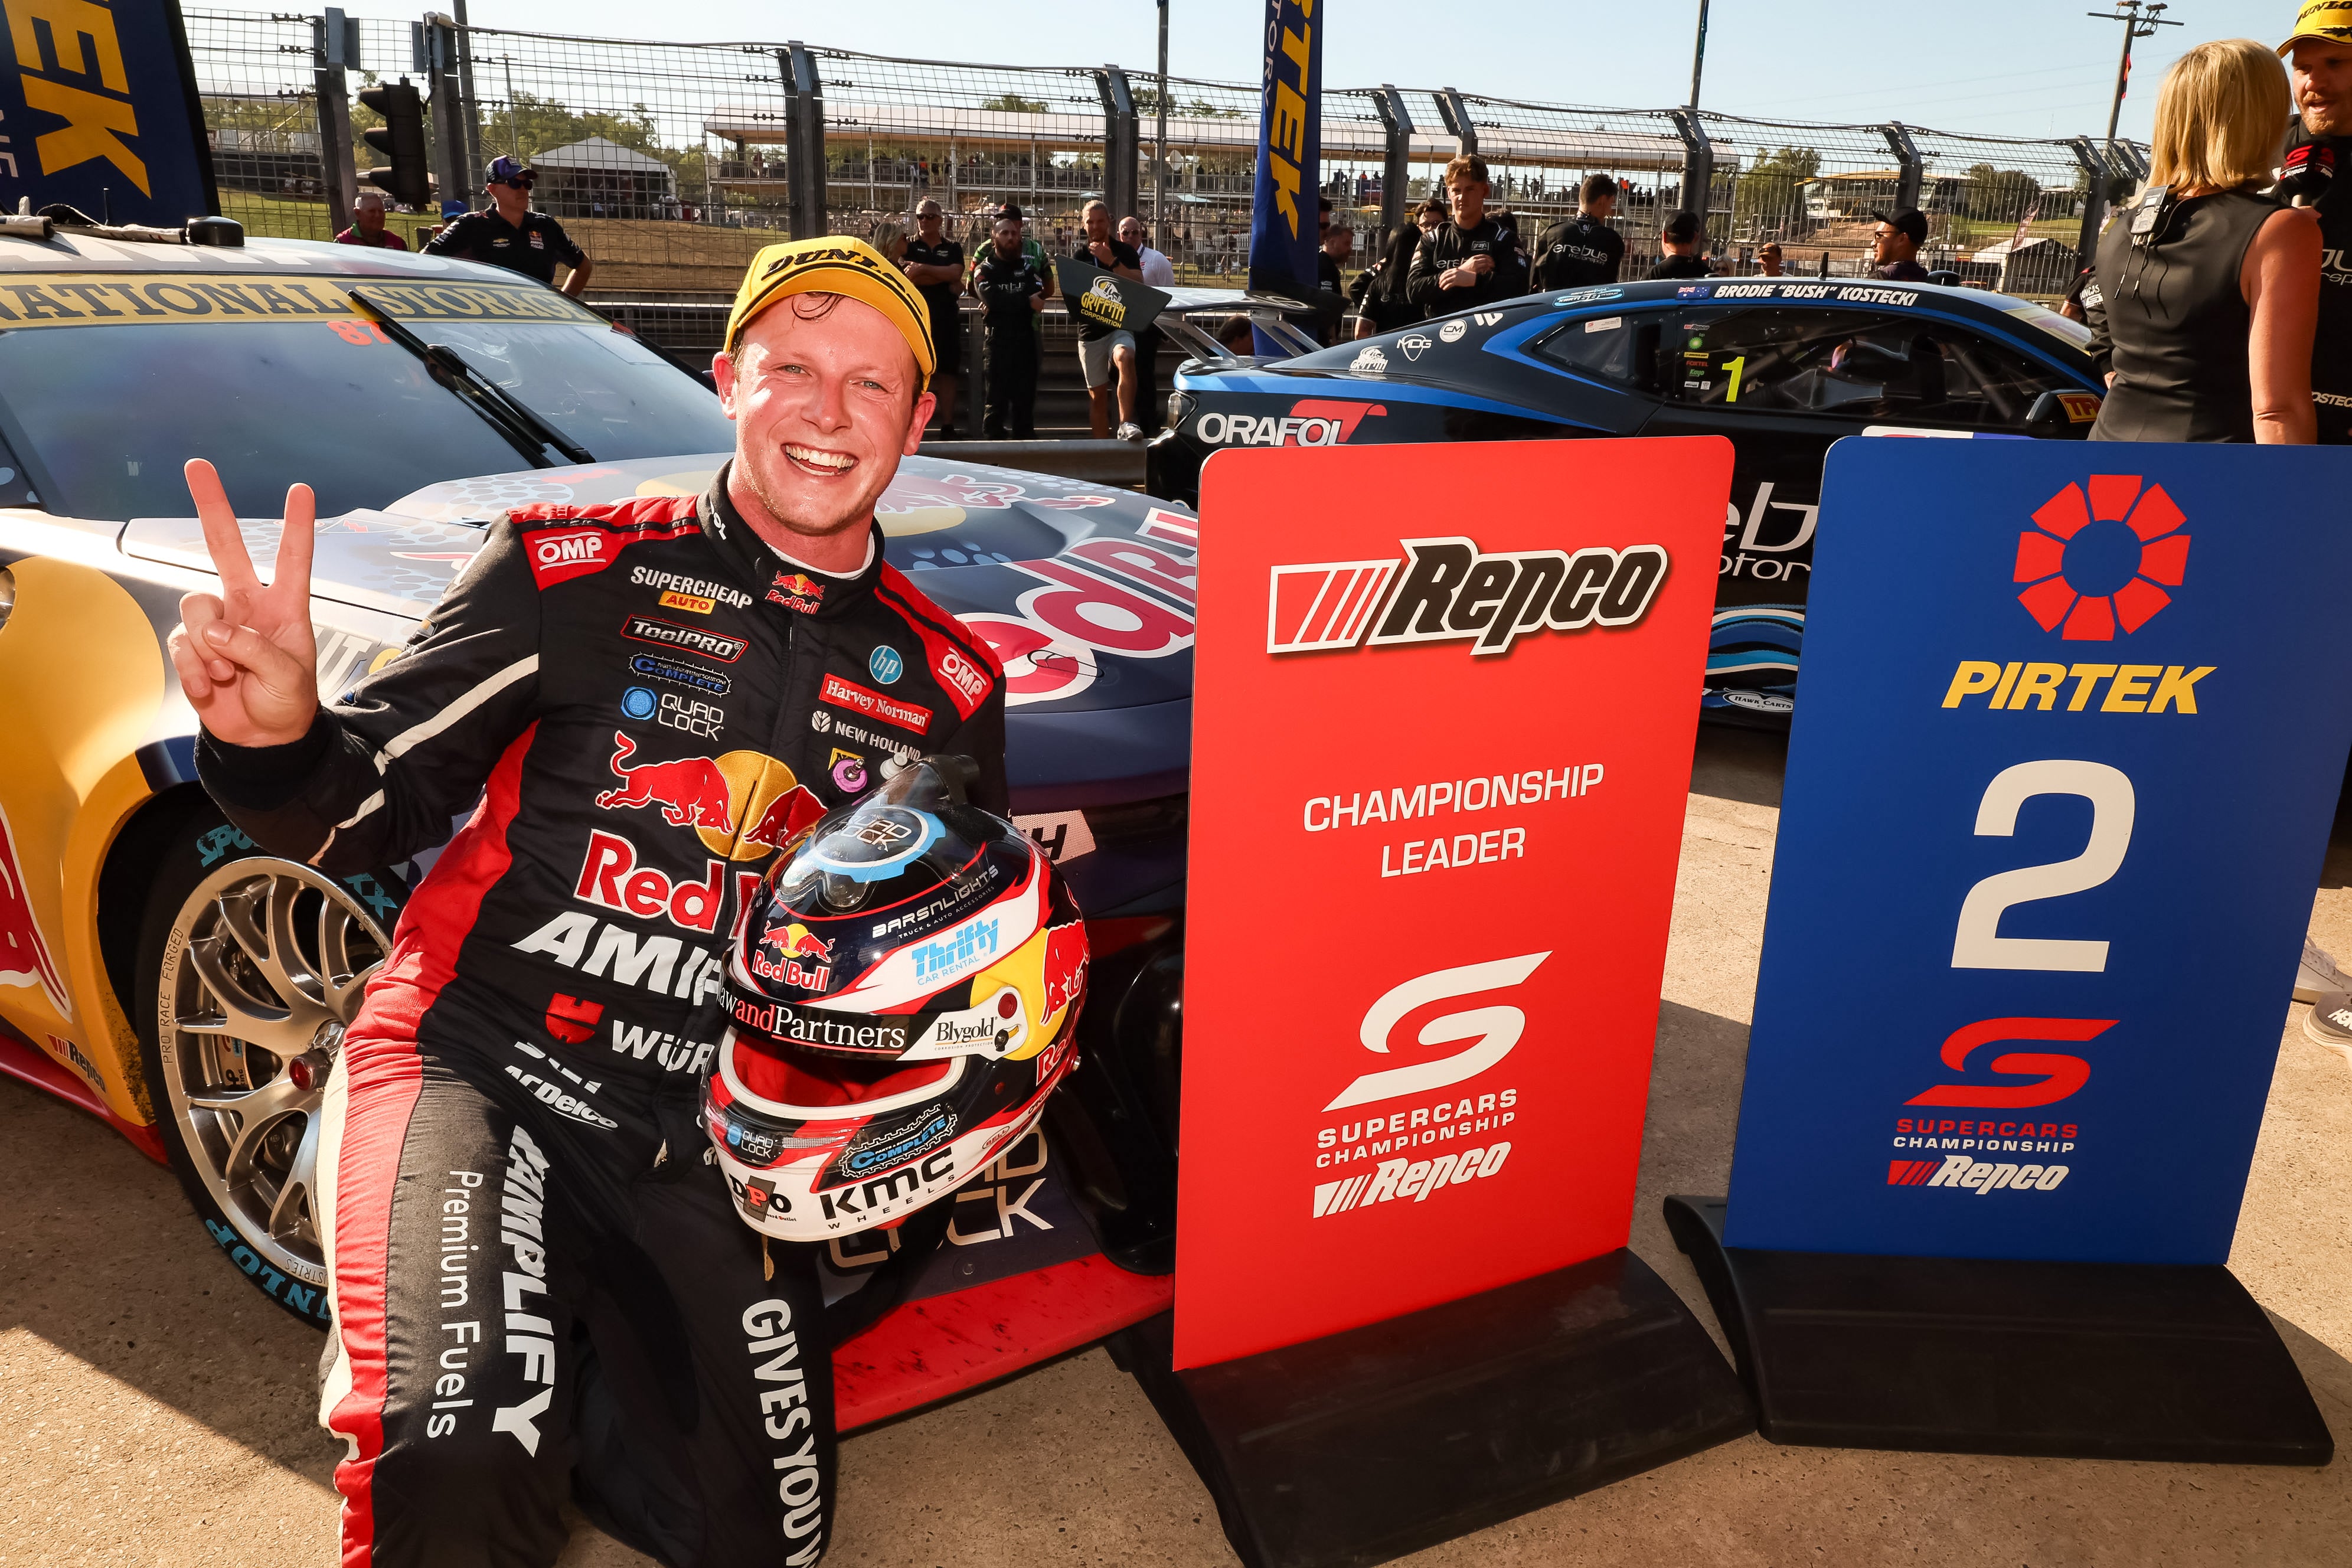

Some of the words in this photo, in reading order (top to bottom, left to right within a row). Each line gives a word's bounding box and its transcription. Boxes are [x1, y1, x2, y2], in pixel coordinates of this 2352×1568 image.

[1553, 244, 1608, 262] erebus
[355, 285, 593, 321] STORAGE
[1081, 292, 1126, 322] GRIFFITH
[1714, 285, 1776, 298] BRODIE
[1837, 286, 1919, 308] KOSTECKI
[1080, 309, 1122, 328] CORPORATION
[1444, 325, 1463, 334] CM
[1397, 338, 1432, 349] MDG
[1721, 356, 1745, 402] 1
[1197, 413, 1345, 447] ORAFOL
[537, 536, 603, 564] OMP
[631, 566, 753, 609] SUPERCHEAP
[666, 594, 710, 610] AUTO
[765, 589, 794, 608] Red
[792, 597, 821, 615] Bull
[1365, 535, 1668, 656] Repco
[871, 646, 901, 683] hp
[942, 654, 983, 695] OMP
[661, 692, 724, 724] QUAD
[826, 680, 876, 711] Harvey
[877, 700, 926, 728] Norman
[1733, 695, 1760, 705] HAWK
[1763, 700, 1792, 708] CARTS
[1941, 661, 2218, 714] PIRTEK
[658, 708, 723, 741] LOCK
[835, 720, 868, 744] NEW
[870, 734, 921, 761] HOLLAND
[1303, 763, 1604, 832] CHAMPIONSHIP
[1381, 827, 1526, 878] LEADER
[1951, 759, 2135, 972] 2
[573, 828, 726, 934] Red
[898, 926, 923, 939] TRUCK
[933, 912, 952, 925] AUTO
[956, 886, 995, 913] ACCESSORIES
[161, 927, 184, 981] FORGED
[912, 918, 998, 978] Thrifty
[752, 949, 787, 983] Red
[785, 961, 830, 992] Bull
[917, 973, 939, 986] CAR
[942, 956, 981, 976] RENTAL
[160, 992, 171, 1027] RACE
[164, 1035, 174, 1064] PRO
[936, 1017, 994, 1044] Blygold
[64, 1037, 107, 1093] Repco
[1317, 1088, 1517, 1149] SUPERCARS
[1896, 1118, 2078, 1139] SUPERCARS
[741, 1141, 772, 1159] LOCK
[742, 1130, 773, 1149] QUAD
[851, 1117, 946, 1169] COMPLETE
[1316, 1112, 1515, 1168] CHAMPIONSHIP
[1893, 1136, 2075, 1152] CHAMPIONSHIP
[729, 1172, 792, 1213] DPO
[1359, 1141, 1512, 1203] Repco
[1927, 1155, 2069, 1195] Repco
[828, 1174, 955, 1230] WHEELS
[439, 1170, 483, 1309] Premium
[426, 1320, 481, 1440] Fuels
[742, 1299, 811, 1439] GIVES
[773, 1433, 821, 1539] YOU
